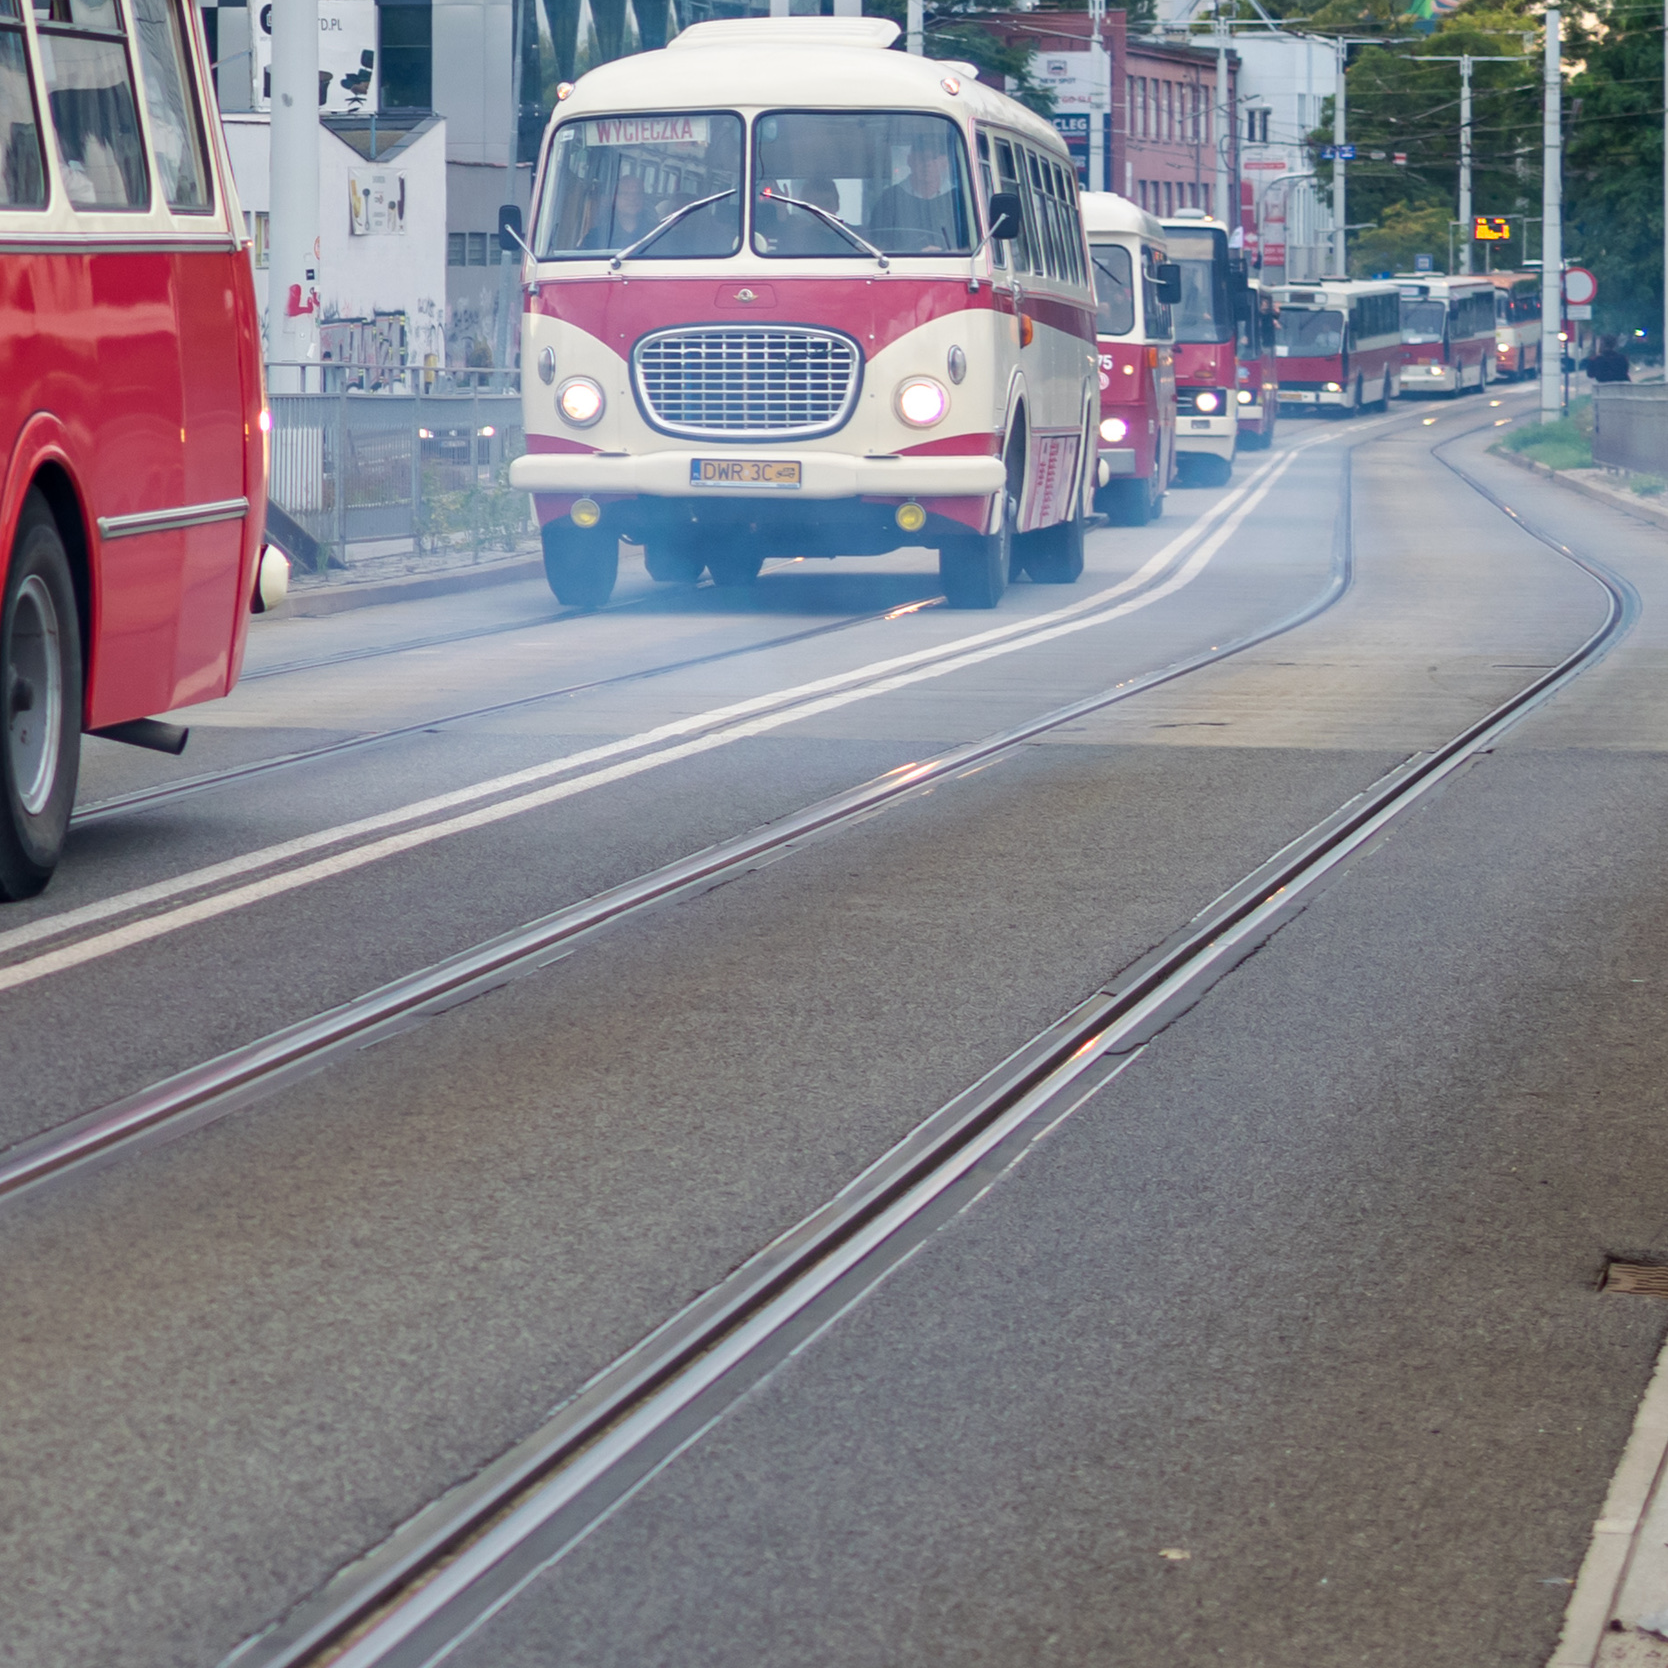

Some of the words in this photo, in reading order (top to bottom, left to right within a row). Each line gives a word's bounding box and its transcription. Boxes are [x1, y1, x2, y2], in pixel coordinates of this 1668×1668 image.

[596, 116, 693, 143] WYCIECZKA
[704, 462, 743, 481] DWR
[751, 463, 772, 481] 3C
